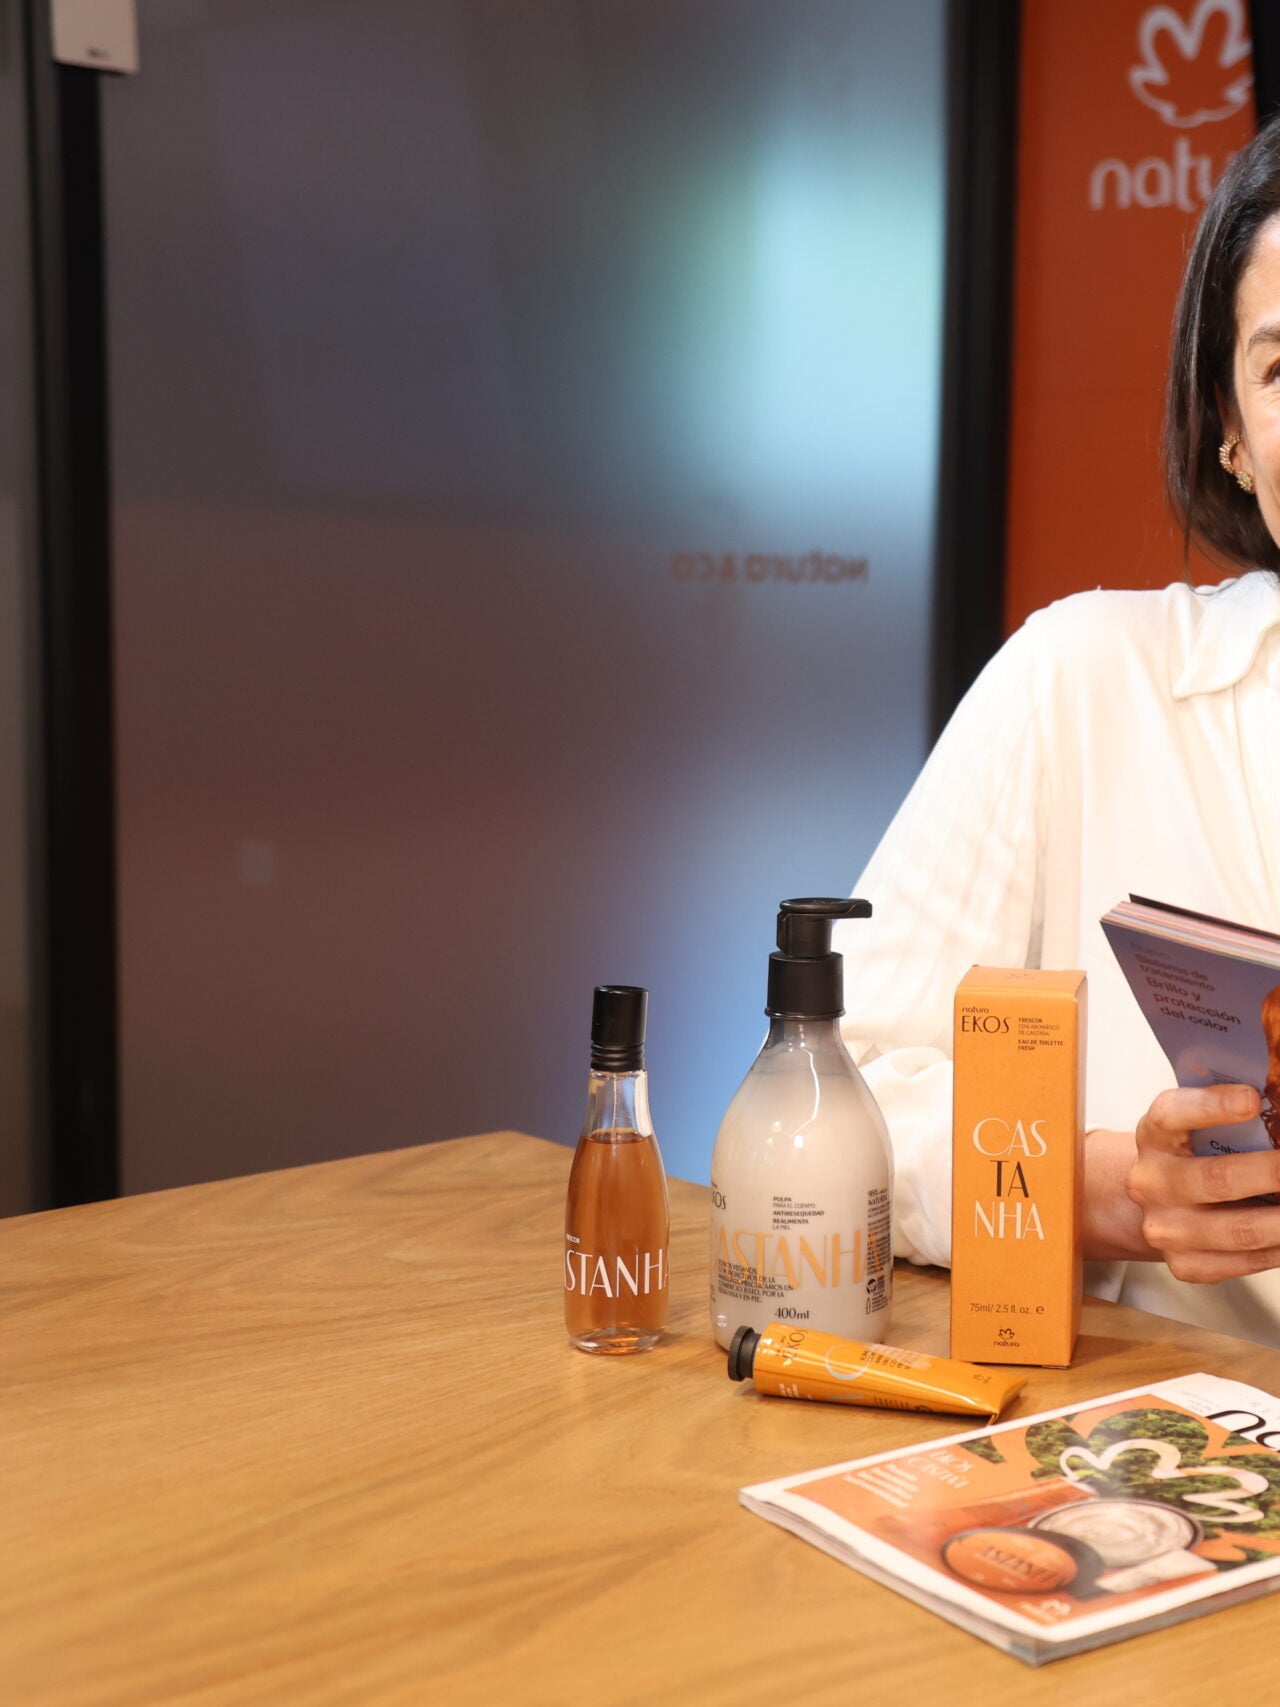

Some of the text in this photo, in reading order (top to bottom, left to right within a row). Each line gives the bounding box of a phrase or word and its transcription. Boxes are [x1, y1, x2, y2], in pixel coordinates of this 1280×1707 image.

[1146, 976, 1201, 1002] Brillo y
[1153, 992, 1242, 1025] protección
[1160, 1007, 1229, 1033] del color
[961, 1015, 1011, 1034] EKOS
[972, 1117, 1048, 1158] CAS
[989, 1159, 1030, 1198] TA
[975, 1200, 1045, 1240] NHA
[775, 1307, 810, 1320] 400ml
[993, 1340, 1020, 1348] natura
